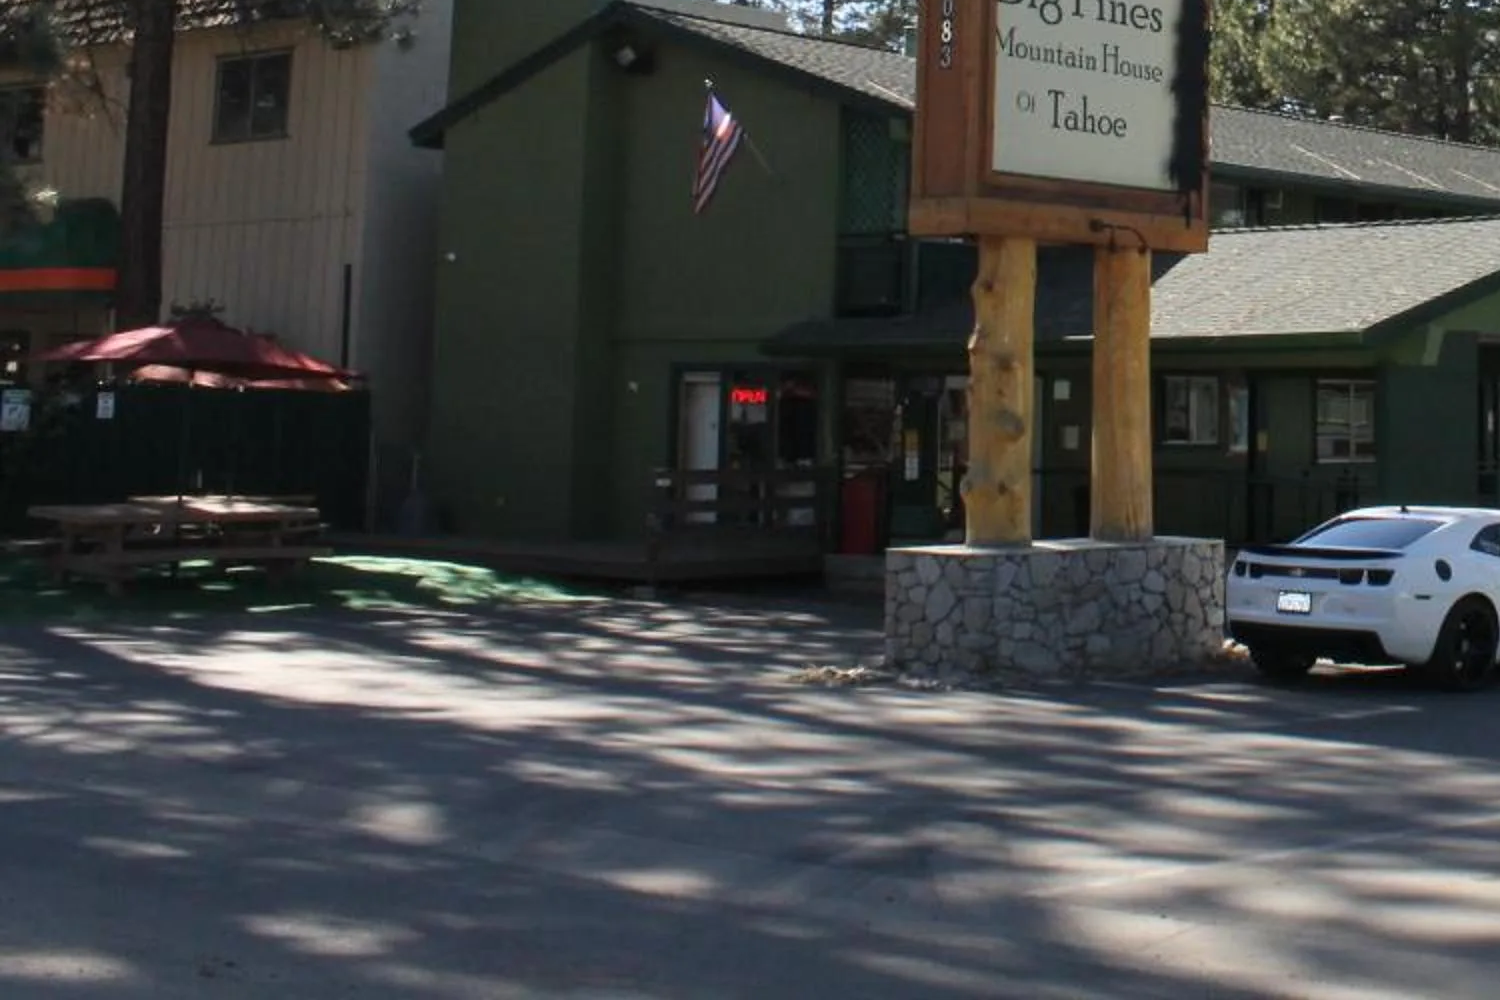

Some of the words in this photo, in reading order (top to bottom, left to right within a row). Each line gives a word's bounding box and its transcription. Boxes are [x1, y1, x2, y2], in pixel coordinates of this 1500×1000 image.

[996, 25, 1097, 70] Mountain
[1102, 42, 1163, 83] House
[1047, 89, 1128, 138] Tahoe
